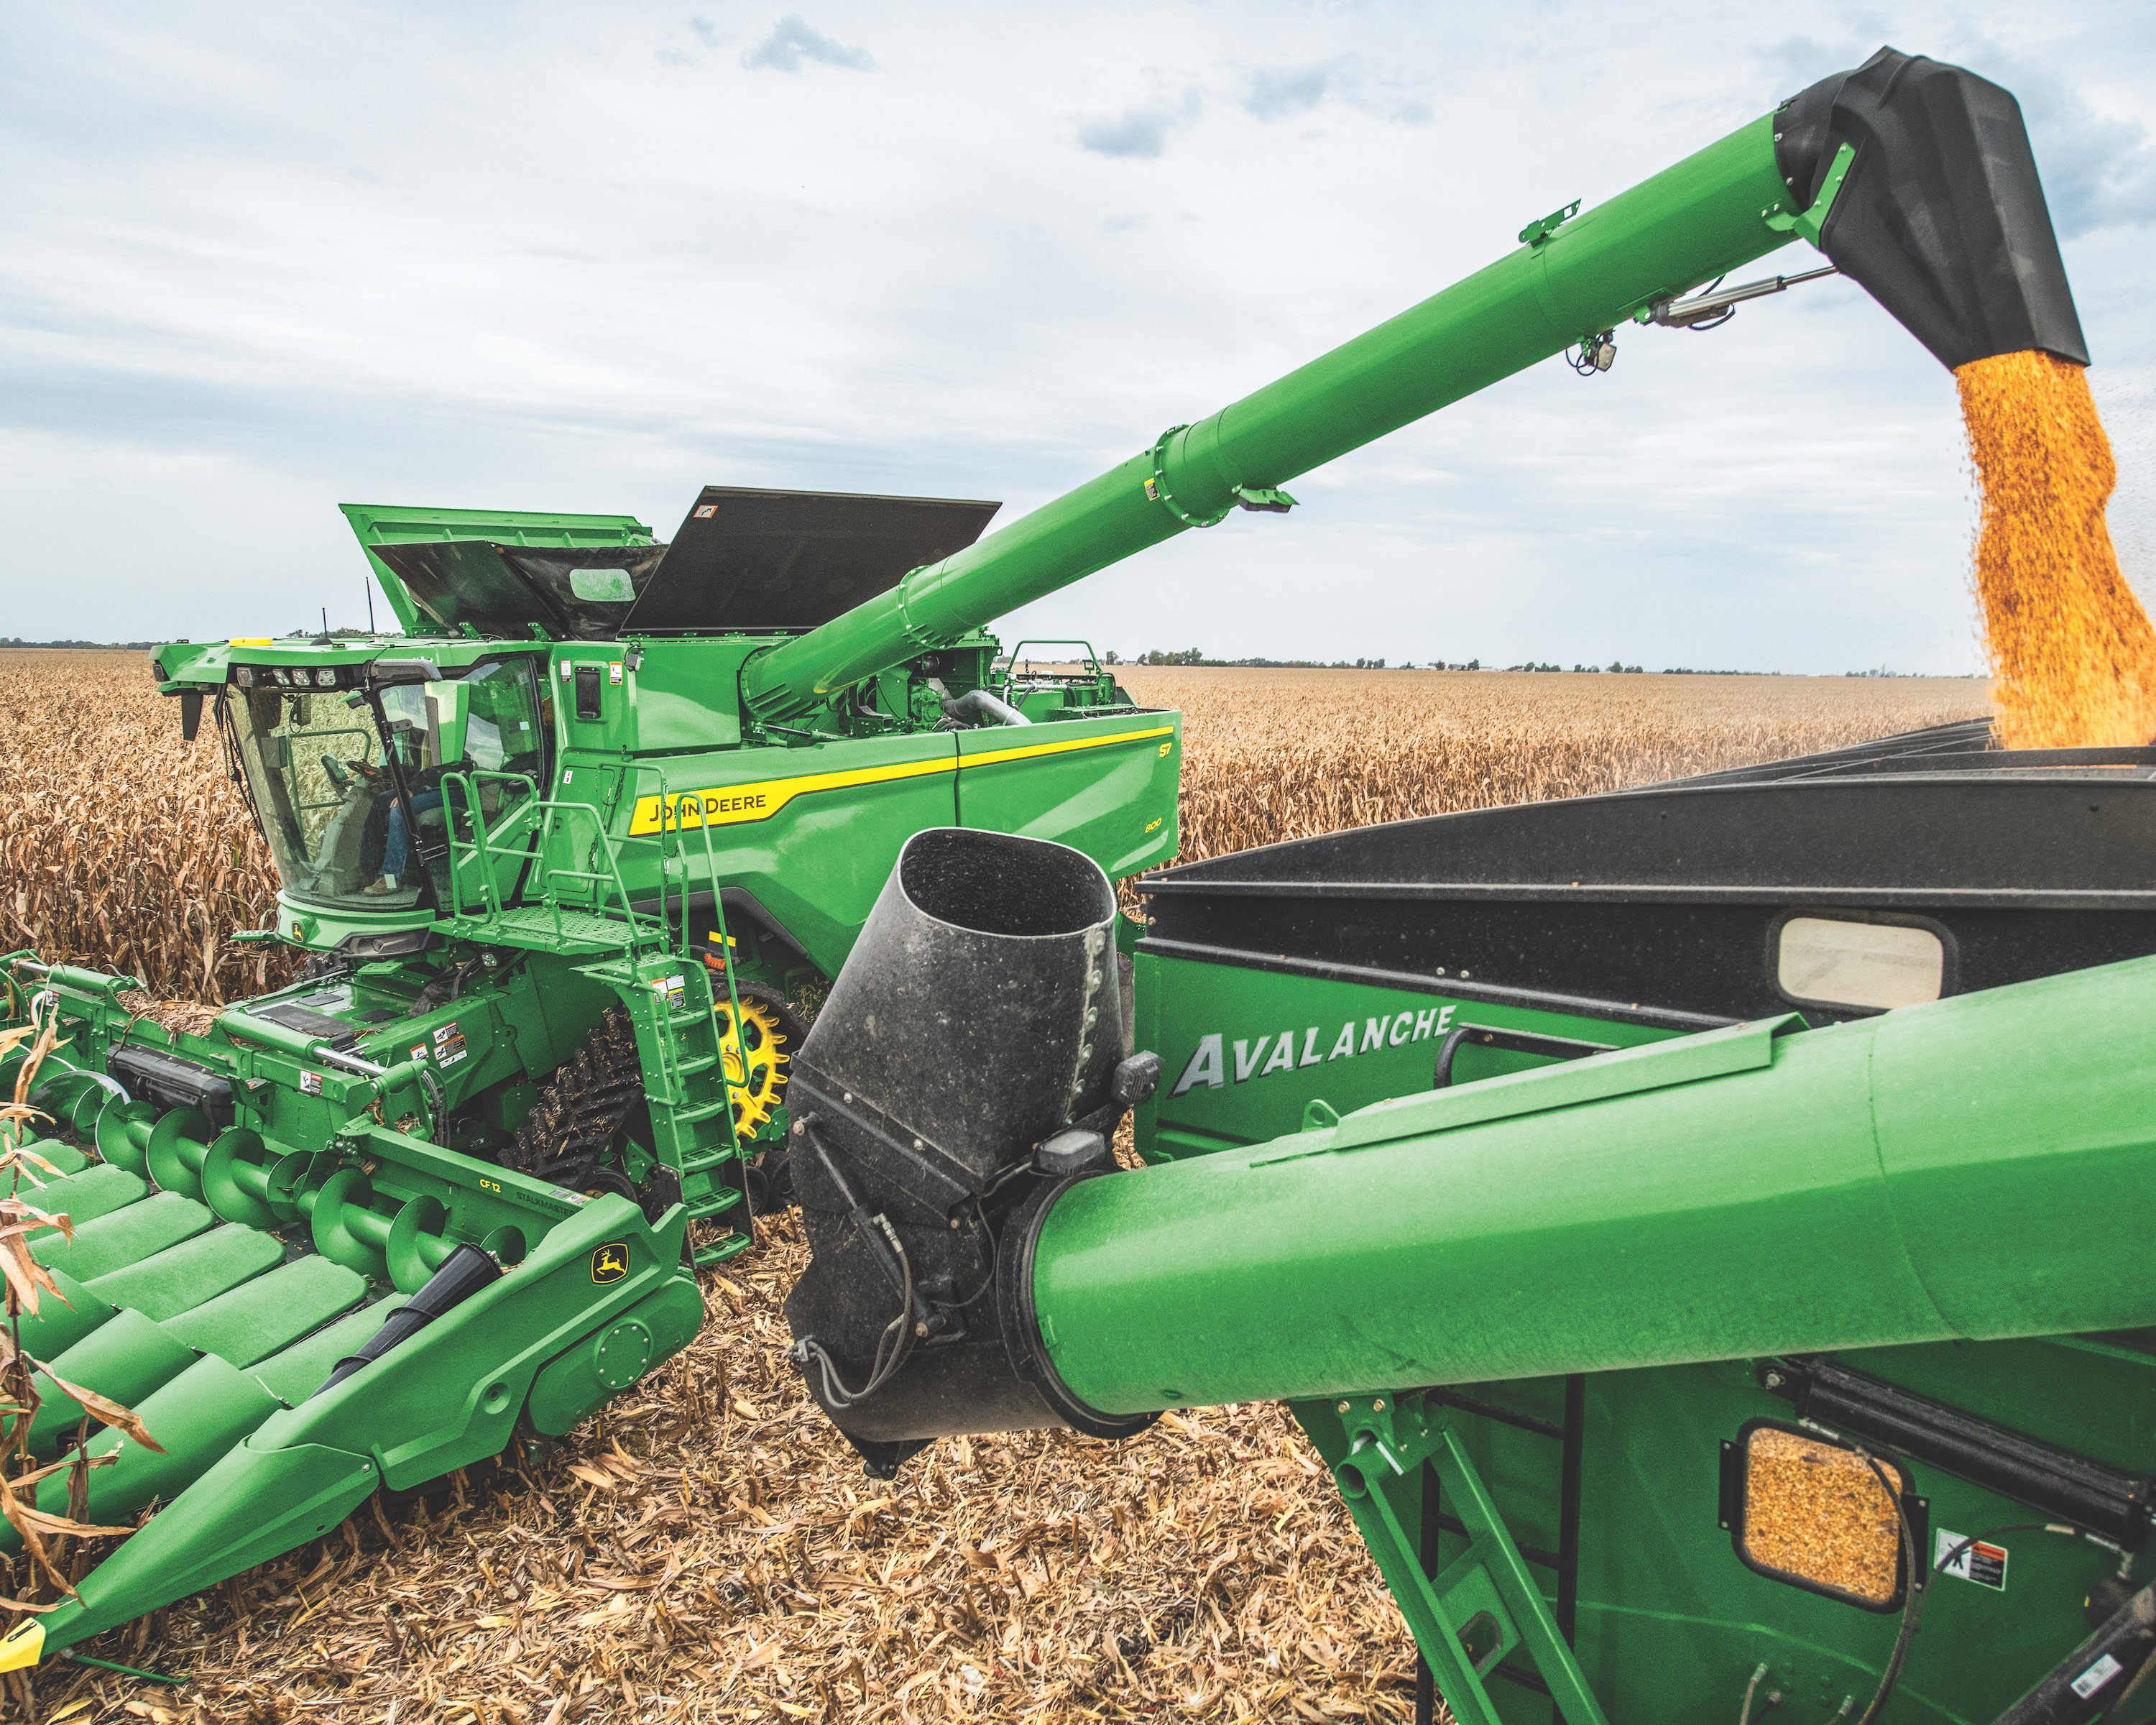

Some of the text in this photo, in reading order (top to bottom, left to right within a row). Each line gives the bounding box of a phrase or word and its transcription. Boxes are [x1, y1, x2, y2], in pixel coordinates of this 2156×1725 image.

[1159, 742, 1171, 758] S7
[650, 795, 766, 822] JOHN DEERE
[1145, 818, 1162, 833] 800
[1166, 1005, 1457, 1098] AVALANCHE
[479, 1179, 490, 1189] CF
[492, 1183, 501, 1193] 12
